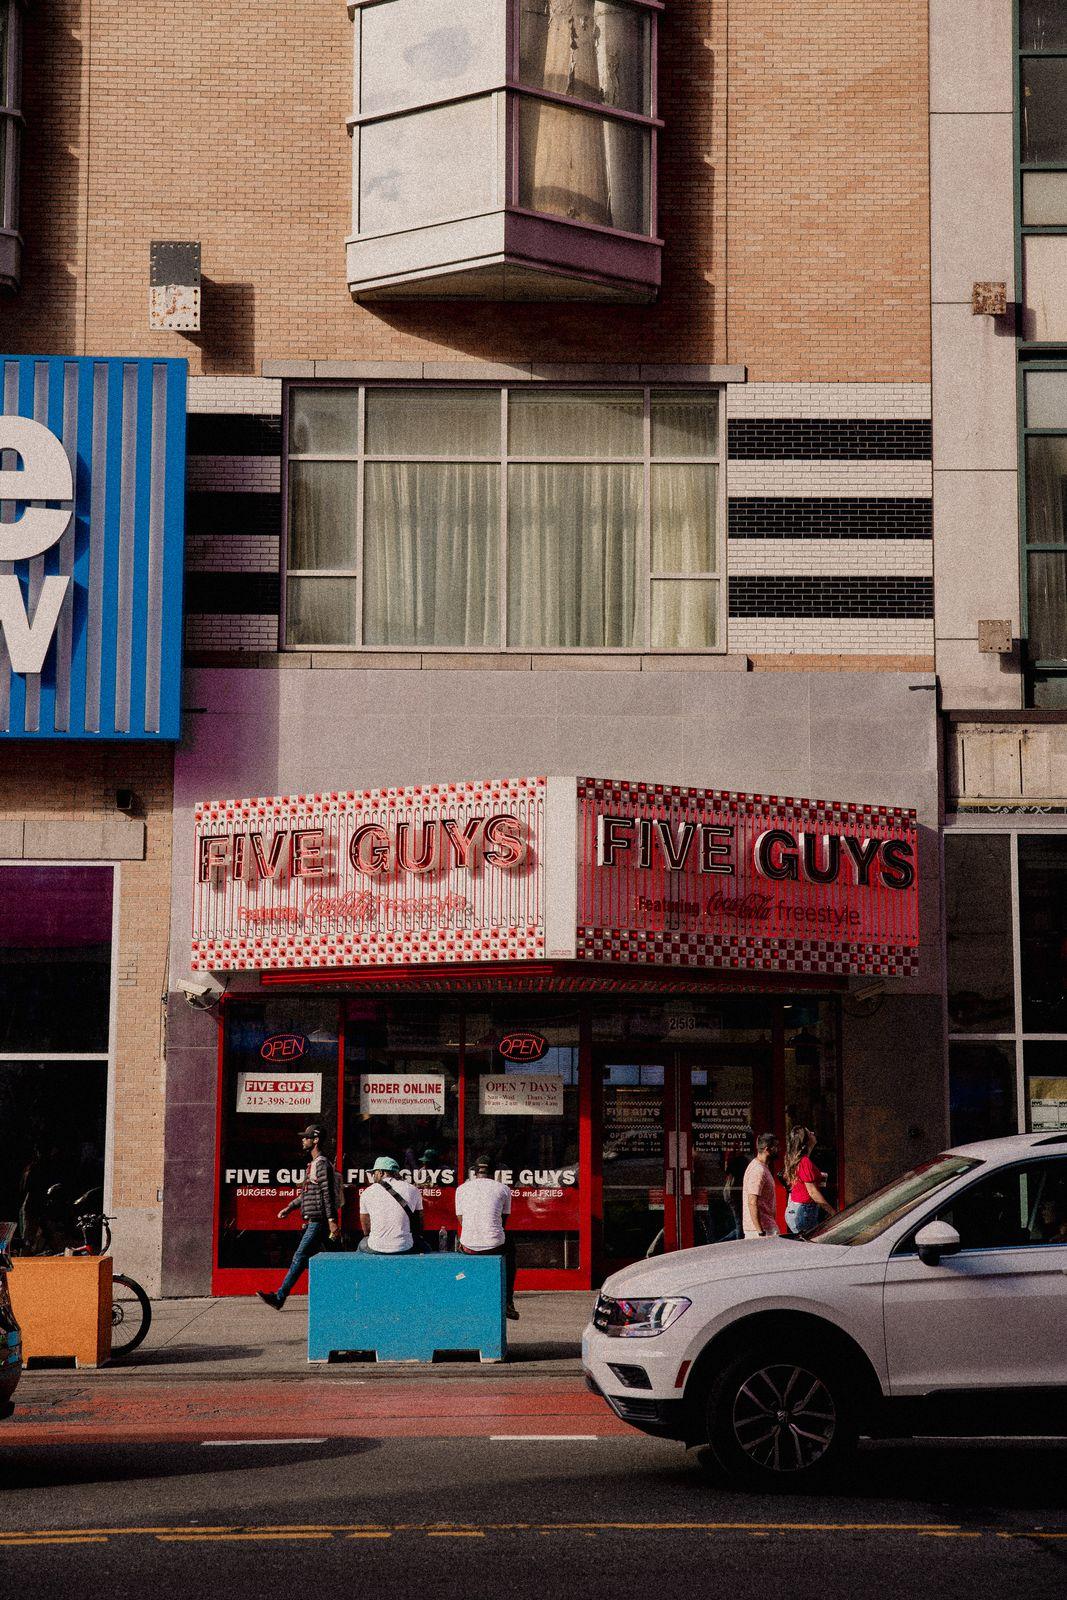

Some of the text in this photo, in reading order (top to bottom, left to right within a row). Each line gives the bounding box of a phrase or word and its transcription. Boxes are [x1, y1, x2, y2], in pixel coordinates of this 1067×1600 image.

[198, 814, 526, 883] FIVE GUYS
[597, 815, 914, 890] FIVE GUYS
[638, 896, 699, 916] Featuring
[778, 900, 860, 926] freestyle
[261, 1038, 304, 1058] OPEN
[500, 1038, 544, 1055] OPEN
[245, 1082, 314, 1092] FIVE GUYS
[363, 1083, 442, 1094] ORDER ONLINE
[486, 1081, 557, 1092] OPEN 7 DAYS
[247, 1096, 311, 1106] 212-398-2600
[371, 1097, 435, 1105] www.fiveguys.com
[695, 1108, 750, 1116] FIVE GUYS
[225, 1168, 270, 1184] FIVE
[398, 1168, 455, 1185] GUYS
[519, 1169, 576, 1185] GUYS
[236, 1188, 277, 1197] BURGERS
[279, 1188, 294, 1197] and
[522, 1189, 537, 1197] and
[539, 1189, 563, 1197] FRIES
